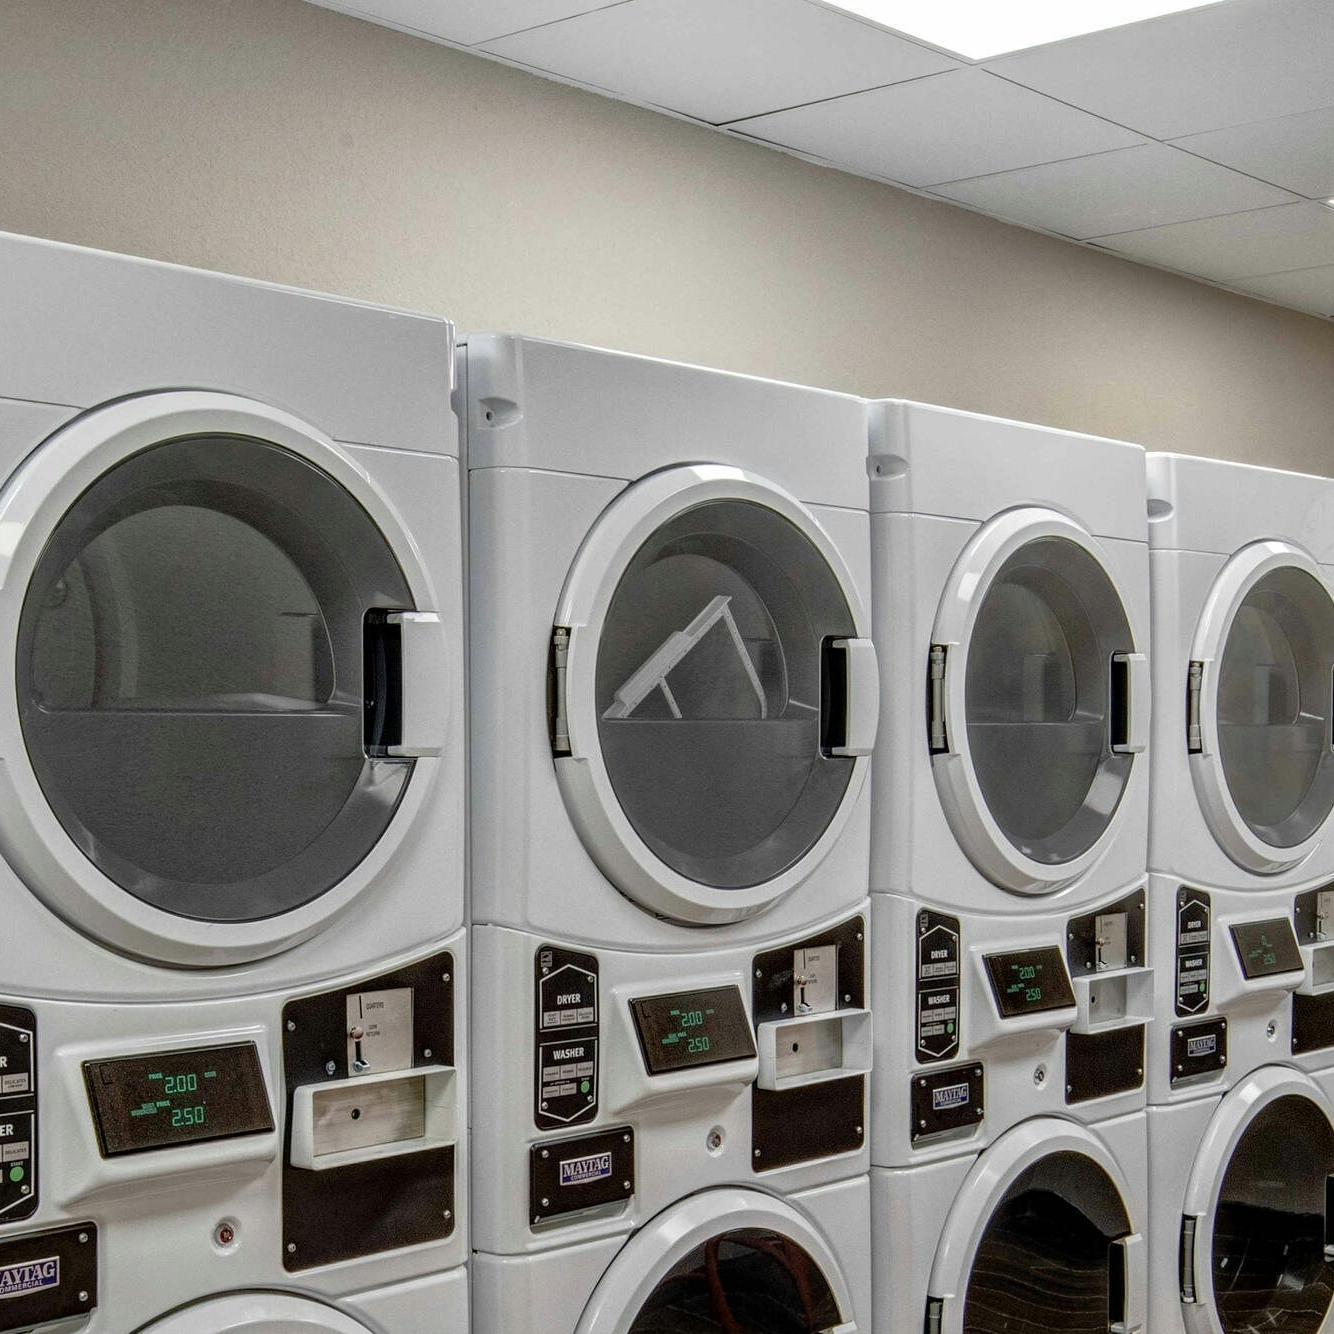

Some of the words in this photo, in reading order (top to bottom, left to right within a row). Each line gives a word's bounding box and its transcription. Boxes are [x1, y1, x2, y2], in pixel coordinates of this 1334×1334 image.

[931, 950, 948, 959] DRYER
[557, 993, 581, 1005] DRYER
[928, 995, 950, 1005] WASHER
[1189, 1037, 1214, 1049] MAYTAG
[553, 1047, 584, 1060] WASHER
[165, 1074, 197, 1094] 2.00
[934, 1087, 967, 1102] MAYTAG
[172, 1106, 204, 1127] 2.50
[563, 1156, 609, 1177] MAYTAG
